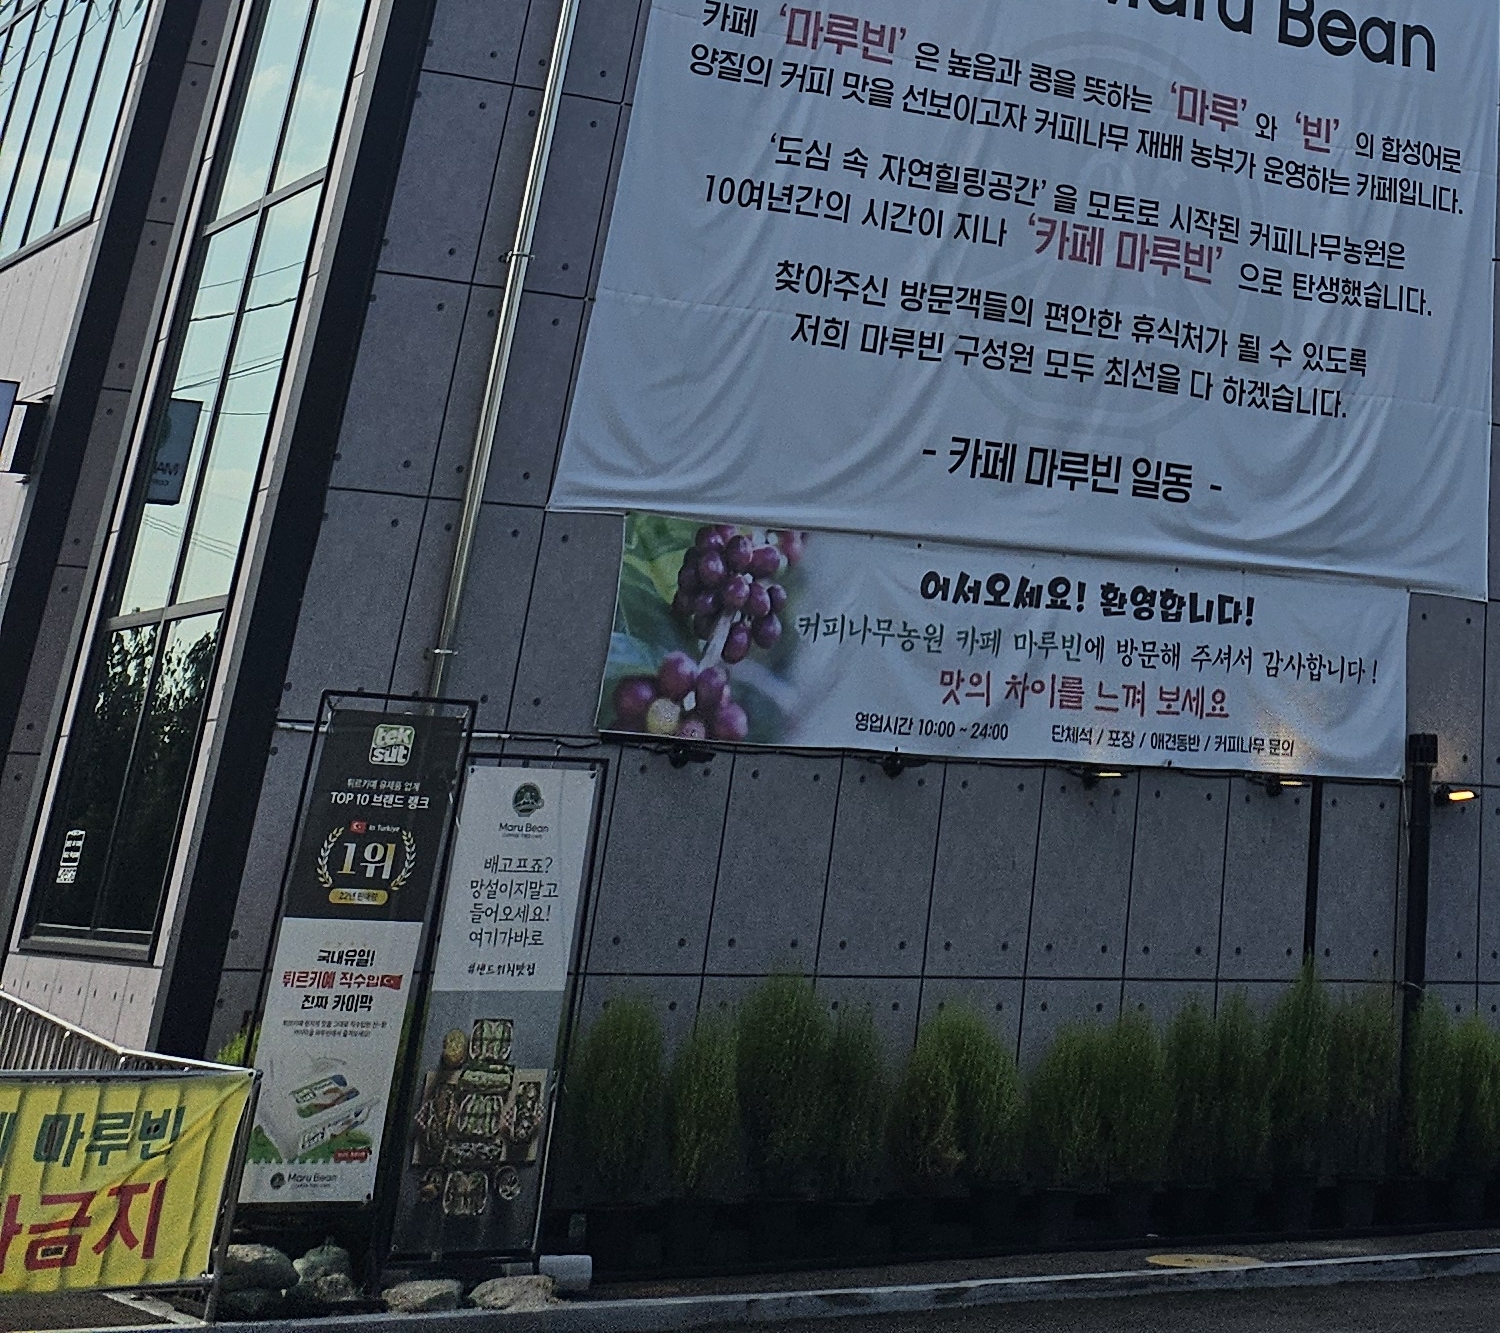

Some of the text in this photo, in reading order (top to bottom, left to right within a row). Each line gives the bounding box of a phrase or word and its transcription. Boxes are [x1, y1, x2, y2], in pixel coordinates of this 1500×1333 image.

[703, 0, 758, 37] 카페
[914, 42, 940, 71] 은
[948, 48, 1022, 87] 높음과
[1029, 63, 1076, 99] 콩을
[1083, 76, 1153, 113] 뜻하는
[1255, 112, 1278, 141] 와
[1355, 132, 1374, 159] 의
[1381, 136, 1461, 174] 합성어로
[689, 43, 1462, 214] 양질의 커피 맛을 선보이고자 커피나무 재배 농부가 운영하는 카페입니다.
[843, 147, 868, 178] 속
[1054, 184, 1077, 213] 을
[1087, 191, 1160, 227] 모토로
[1170, 204, 1240, 244] 시작된
[1249, 221, 1406, 270] 커피나무농원은
[706, 174, 850, 223] 10여년간의
[862, 199, 944, 238] 시간이
[953, 213, 1007, 247] 지나
[1239, 262, 1283, 296] 으로
[1293, 272, 1432, 317] 탄생했습니다.
[774, 260, 1367, 378] 찾아주신 방문객들의 편안한 휴식처가 될 수 있도록
[791, 314, 1347, 418] 저희 마루빈 구성원 모두 최선을 다 하겠습니다.
[948, 436, 1017, 483] 카페
[1025, 446, 1121, 494] 마루빈
[1132, 457, 1193, 503] 일동
[920, 571, 1255, 627] 어서오세요! 환영합니다!
[799, 613, 944, 654] 커피나무농원
[957, 625, 1002, 659] 카페
[1014, 630, 1105, 662] 마루빈에
[1117, 638, 1181, 672] 방문해
[1191, 644, 1252, 675] 주셔서
[940, 669, 1230, 720] 맛의 차이를 느껴 보세요
[855, 711, 913, 736] 영업시간
[918, 718, 956, 738] 10:00
[971, 723, 1008, 741] 24:00
[1051, 724, 1093, 745] 단체석
[1107, 730, 1135, 749] 포장
[1150, 732, 1201, 753] 애견동반
[1214, 735, 1265, 755] 커피나무
[331, 792, 430, 809] TOP 10 브랜드 랭크
[499, 822, 523, 832] Maru
[470, 879, 558, 900] 망설이지말고
[484, 856, 553, 874] 배고프죠?
[469, 928, 544, 948] 여기가바로
[470, 903, 550, 924] 들어오세요!
[317, 949, 375, 967] 국내유일!
[301, 994, 373, 1012] 진짜 카이막
[33, 1106, 186, 1167] 마루빈
